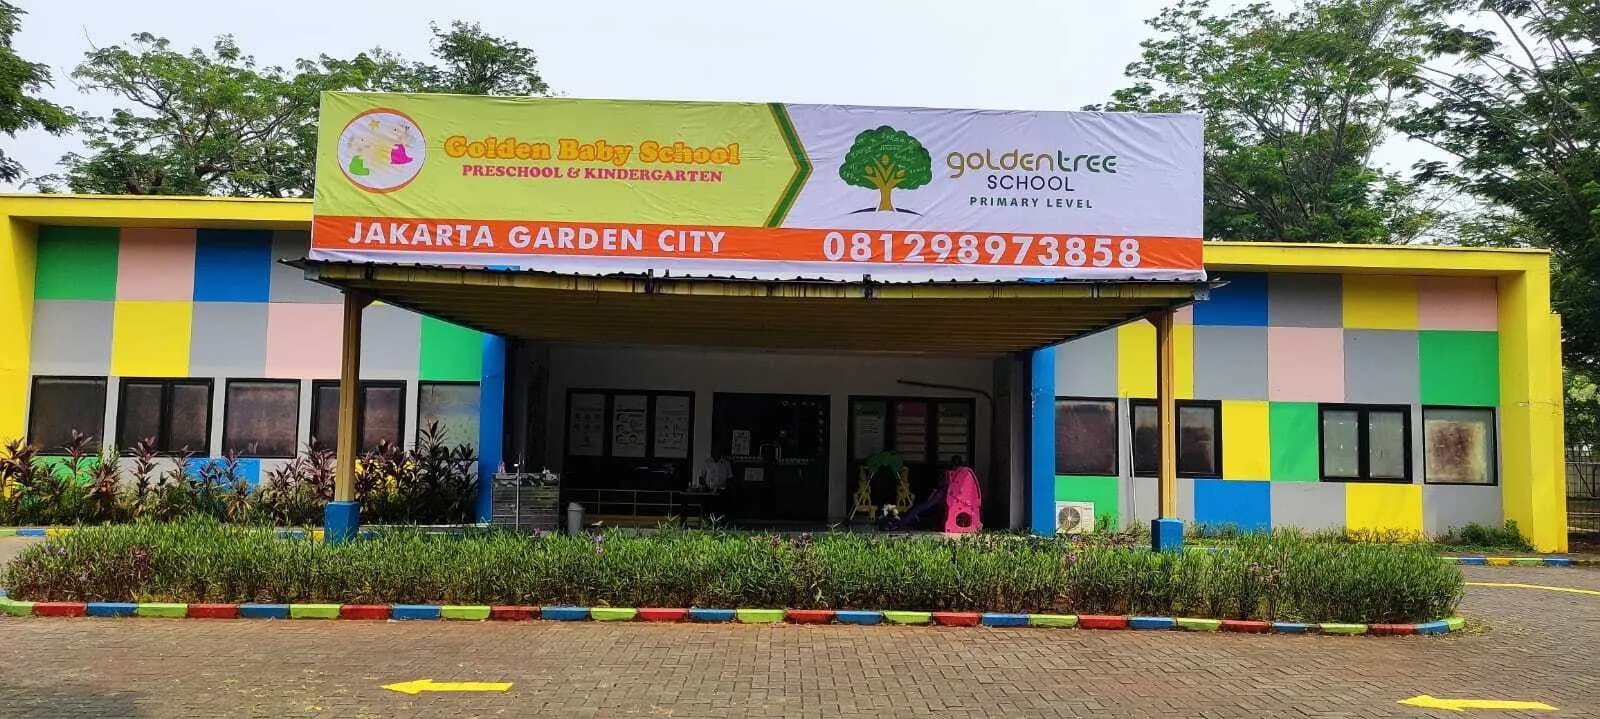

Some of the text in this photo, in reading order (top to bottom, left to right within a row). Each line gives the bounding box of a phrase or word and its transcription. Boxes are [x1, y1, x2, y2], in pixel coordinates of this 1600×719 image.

[444, 135, 741, 165] Golden Baby School
[462, 165, 723, 182] PRESCHOOL & KINDERGARTEN
[987, 175, 1075, 192] SCHOOL
[970, 196, 1093, 209] PRIMARY LEVEL
[348, 222, 727, 253] JAKARTA GARDEN CITY
[823, 232, 1142, 267] 081298973858
